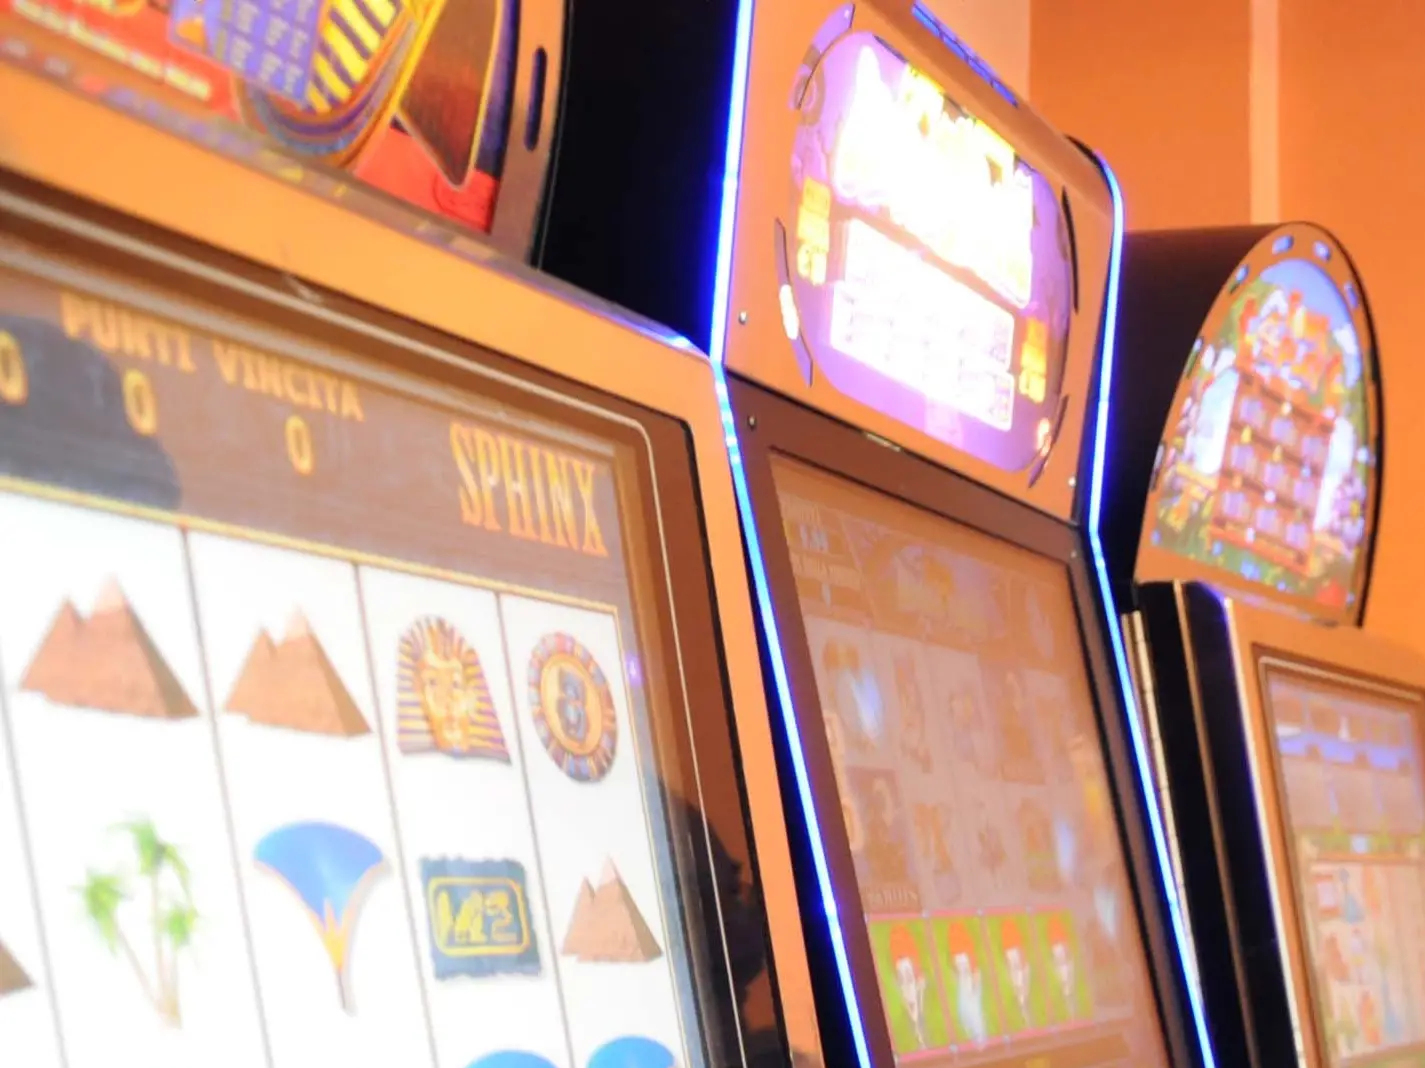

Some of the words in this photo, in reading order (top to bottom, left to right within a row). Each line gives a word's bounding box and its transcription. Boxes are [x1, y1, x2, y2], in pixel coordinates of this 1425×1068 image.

[121, 369, 157, 435] 0
[285, 415, 314, 474] 0
[212, 339, 366, 421] VINCITA
[450, 423, 609, 557] SPHINX
